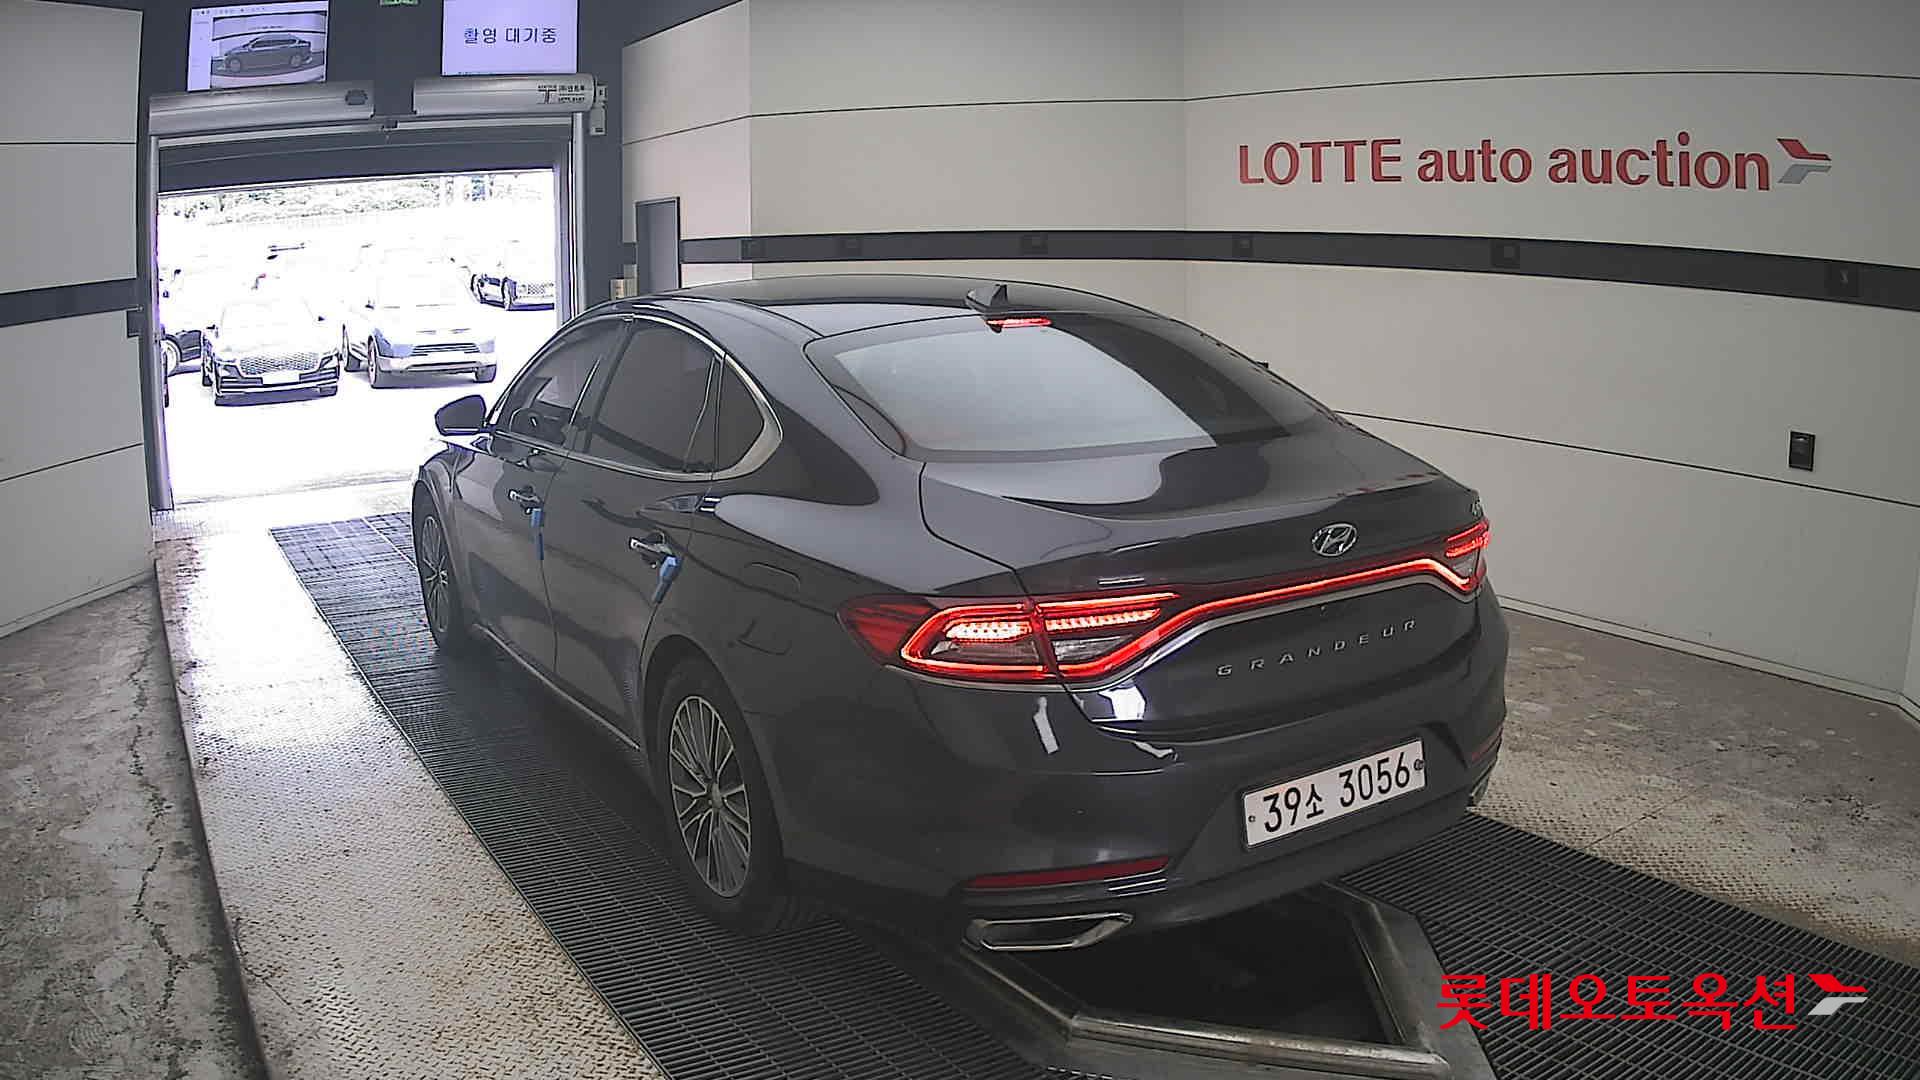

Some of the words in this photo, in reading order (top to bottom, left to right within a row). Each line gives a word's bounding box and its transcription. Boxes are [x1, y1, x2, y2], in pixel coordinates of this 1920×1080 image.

[505, 27, 557, 44] 대기중
[1239, 138, 1402, 185] LOTTE
[1417, 139, 1533, 184] auto
[1548, 131, 1770, 191] auction
[1217, 619, 1416, 676] GRANDEUR
[1263, 784, 1325, 833] 39소
[1338, 752, 1411, 808] 3056
